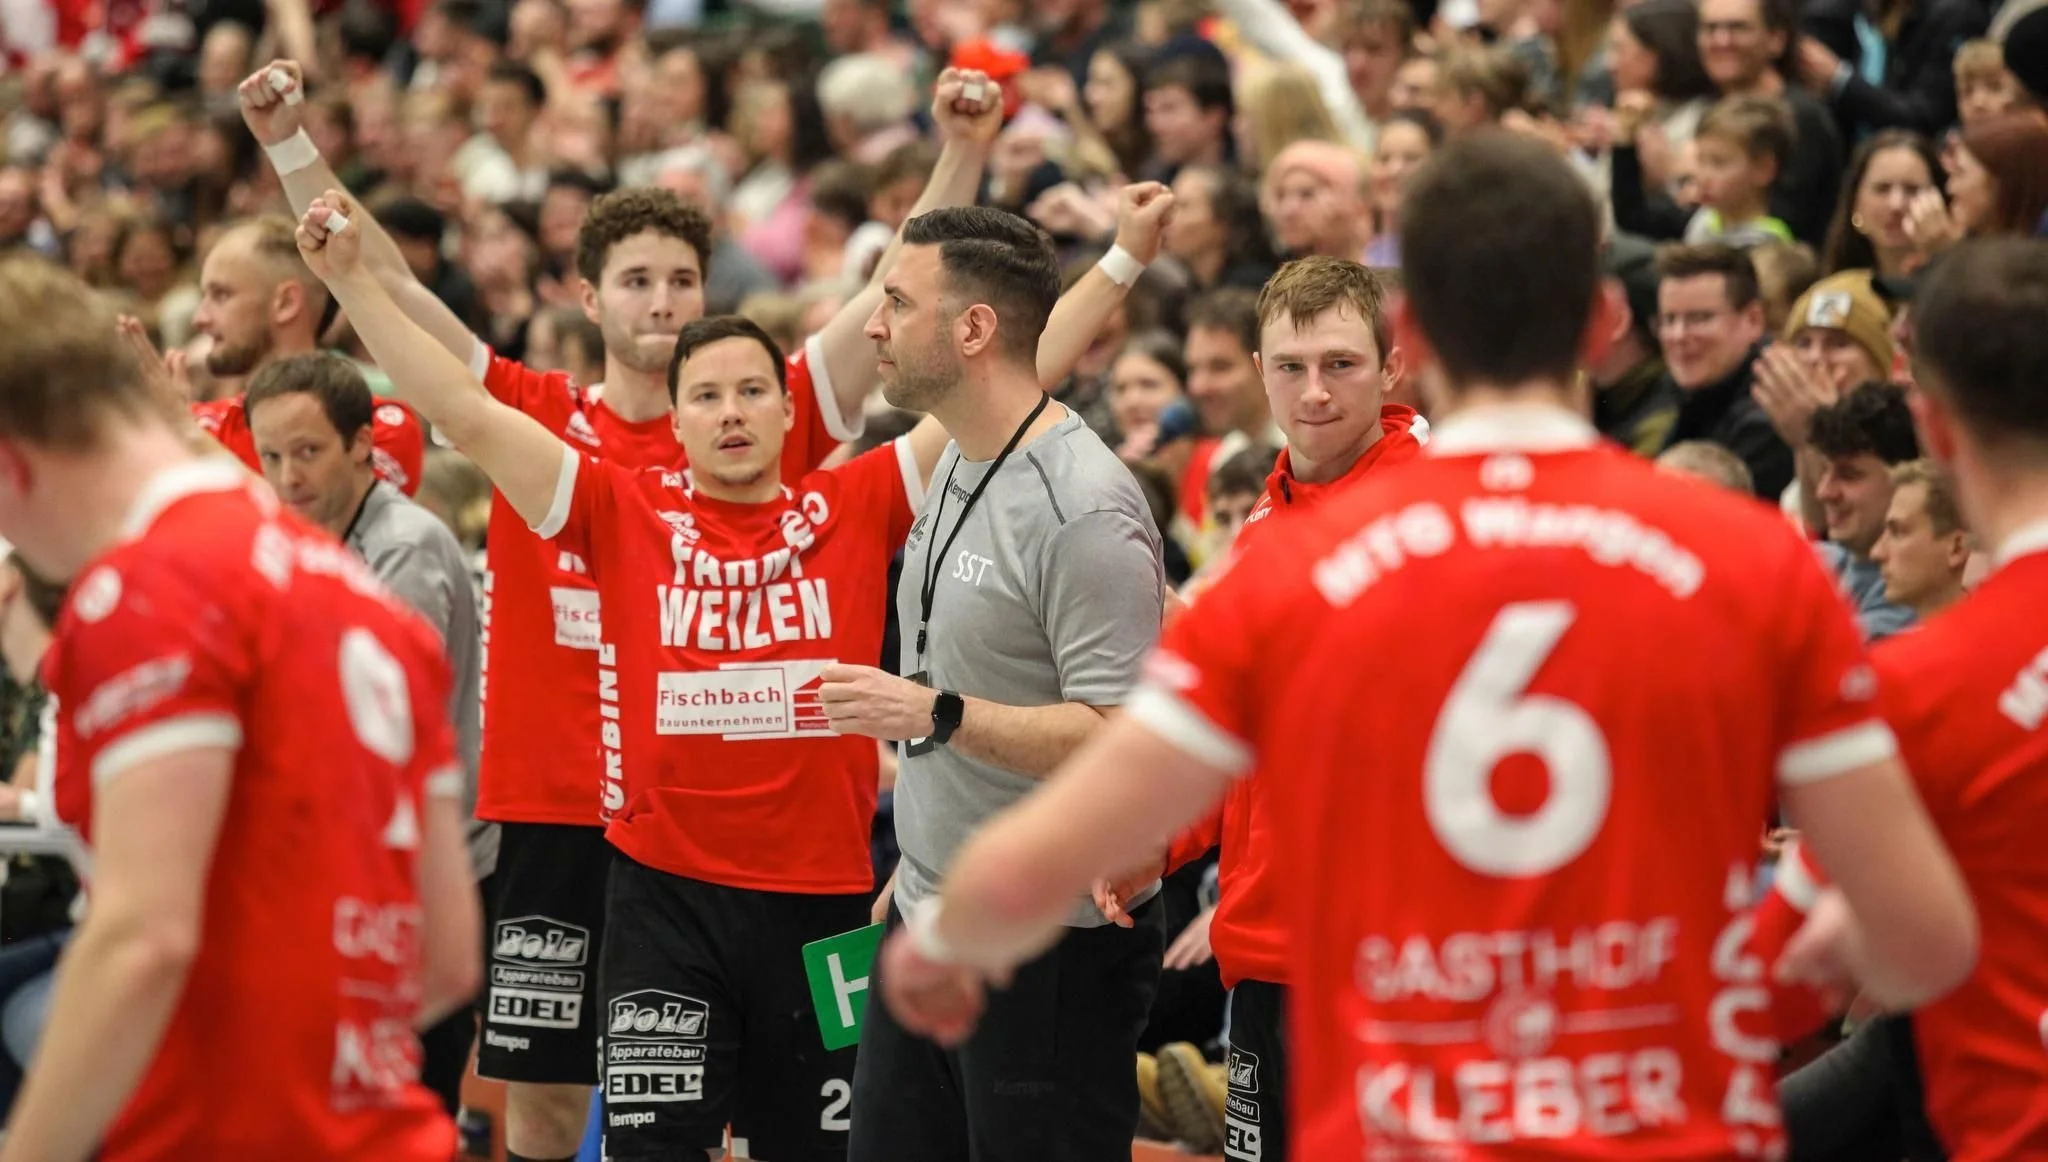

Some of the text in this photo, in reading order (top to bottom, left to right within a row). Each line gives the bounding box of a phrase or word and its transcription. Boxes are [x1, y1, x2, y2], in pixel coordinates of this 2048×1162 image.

[952, 550, 994, 586] SST
[1312, 498, 1706, 608] MTG Wangen
[657, 578, 832, 652] WEIZEN
[660, 687, 782, 706] Fischbach
[659, 716, 783, 728] Bauunternehmen
[1424, 602, 1612, 878] 6
[498, 925, 584, 961] Bolz
[1354, 917, 1680, 1002] GASTHOF
[496, 968, 578, 987] Apparatebau
[609, 1001, 706, 1035] Bolz
[609, 1044, 701, 1061] Apparatebau
[820, 1078, 850, 1130] 2
[1356, 1047, 1689, 1143] KLEBER
